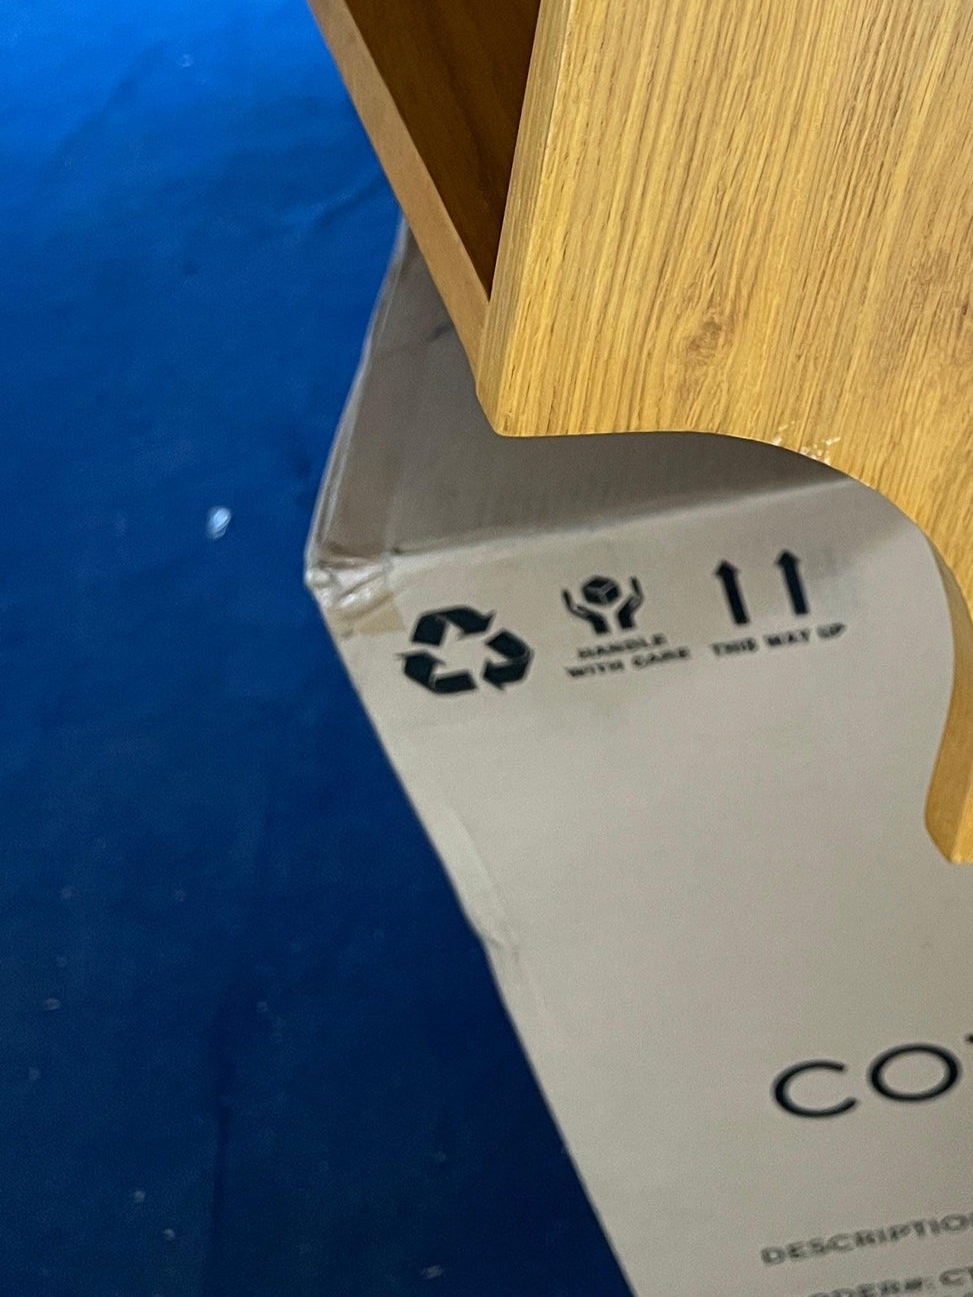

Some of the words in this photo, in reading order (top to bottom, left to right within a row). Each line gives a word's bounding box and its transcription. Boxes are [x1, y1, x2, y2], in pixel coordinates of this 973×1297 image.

[577, 631, 667, 659] HANDLE
[711, 636, 759, 657] THIS
[762, 627, 811, 648] WAY
[566, 659, 625, 678] WITH
[631, 646, 691, 669] CARE
